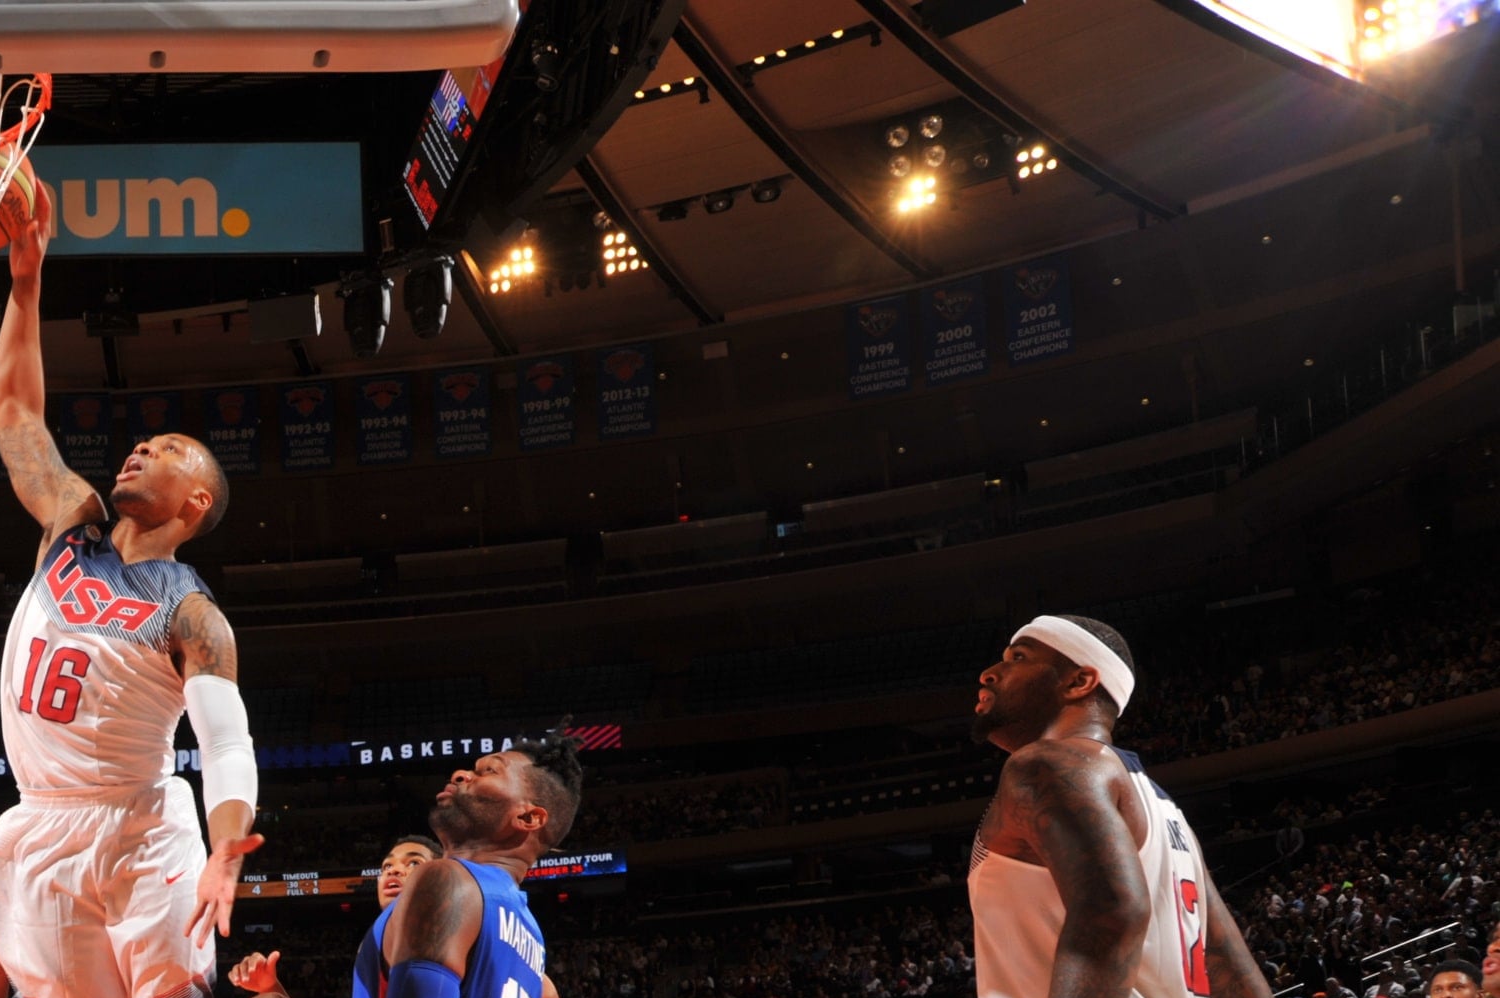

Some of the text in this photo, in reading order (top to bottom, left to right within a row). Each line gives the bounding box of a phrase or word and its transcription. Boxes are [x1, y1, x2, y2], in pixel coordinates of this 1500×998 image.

[1020, 303, 1057, 324] 2002
[936, 325, 972, 344] 2000
[1017, 320, 1061, 337] EASTERN
[1009, 328, 1072, 351] CONFERENCE
[863, 342, 894, 359] 1999
[935, 341, 976, 358] EASTERN
[1013, 341, 1068, 361] CHAMPIONS
[858, 359, 900, 374] EASTERN
[926, 350, 986, 371] CONFERENCE
[850, 367, 910, 385] CONFERENCE
[930, 363, 984, 381] CHAMPIONS
[602, 386, 650, 402] 2012-13
[854, 379, 906, 395] CHAMPIONS
[523, 397, 570, 413] 1998-99
[45, 546, 162, 632] USA
[19, 637, 91, 724] 16
[360, 738, 548, 764] BASKETBA
[540, 856, 582, 867] HOLIDAY
[585, 853, 613, 863] TOUR
[283, 872, 319, 880] TIMEOUTS
[361, 869, 383, 877] ASSIS
[525, 866, 568, 877] CEMBER
[252, 885, 261, 895] 4
[287, 888, 304, 896] FULL
[499, 906, 546, 980] MARTINE
